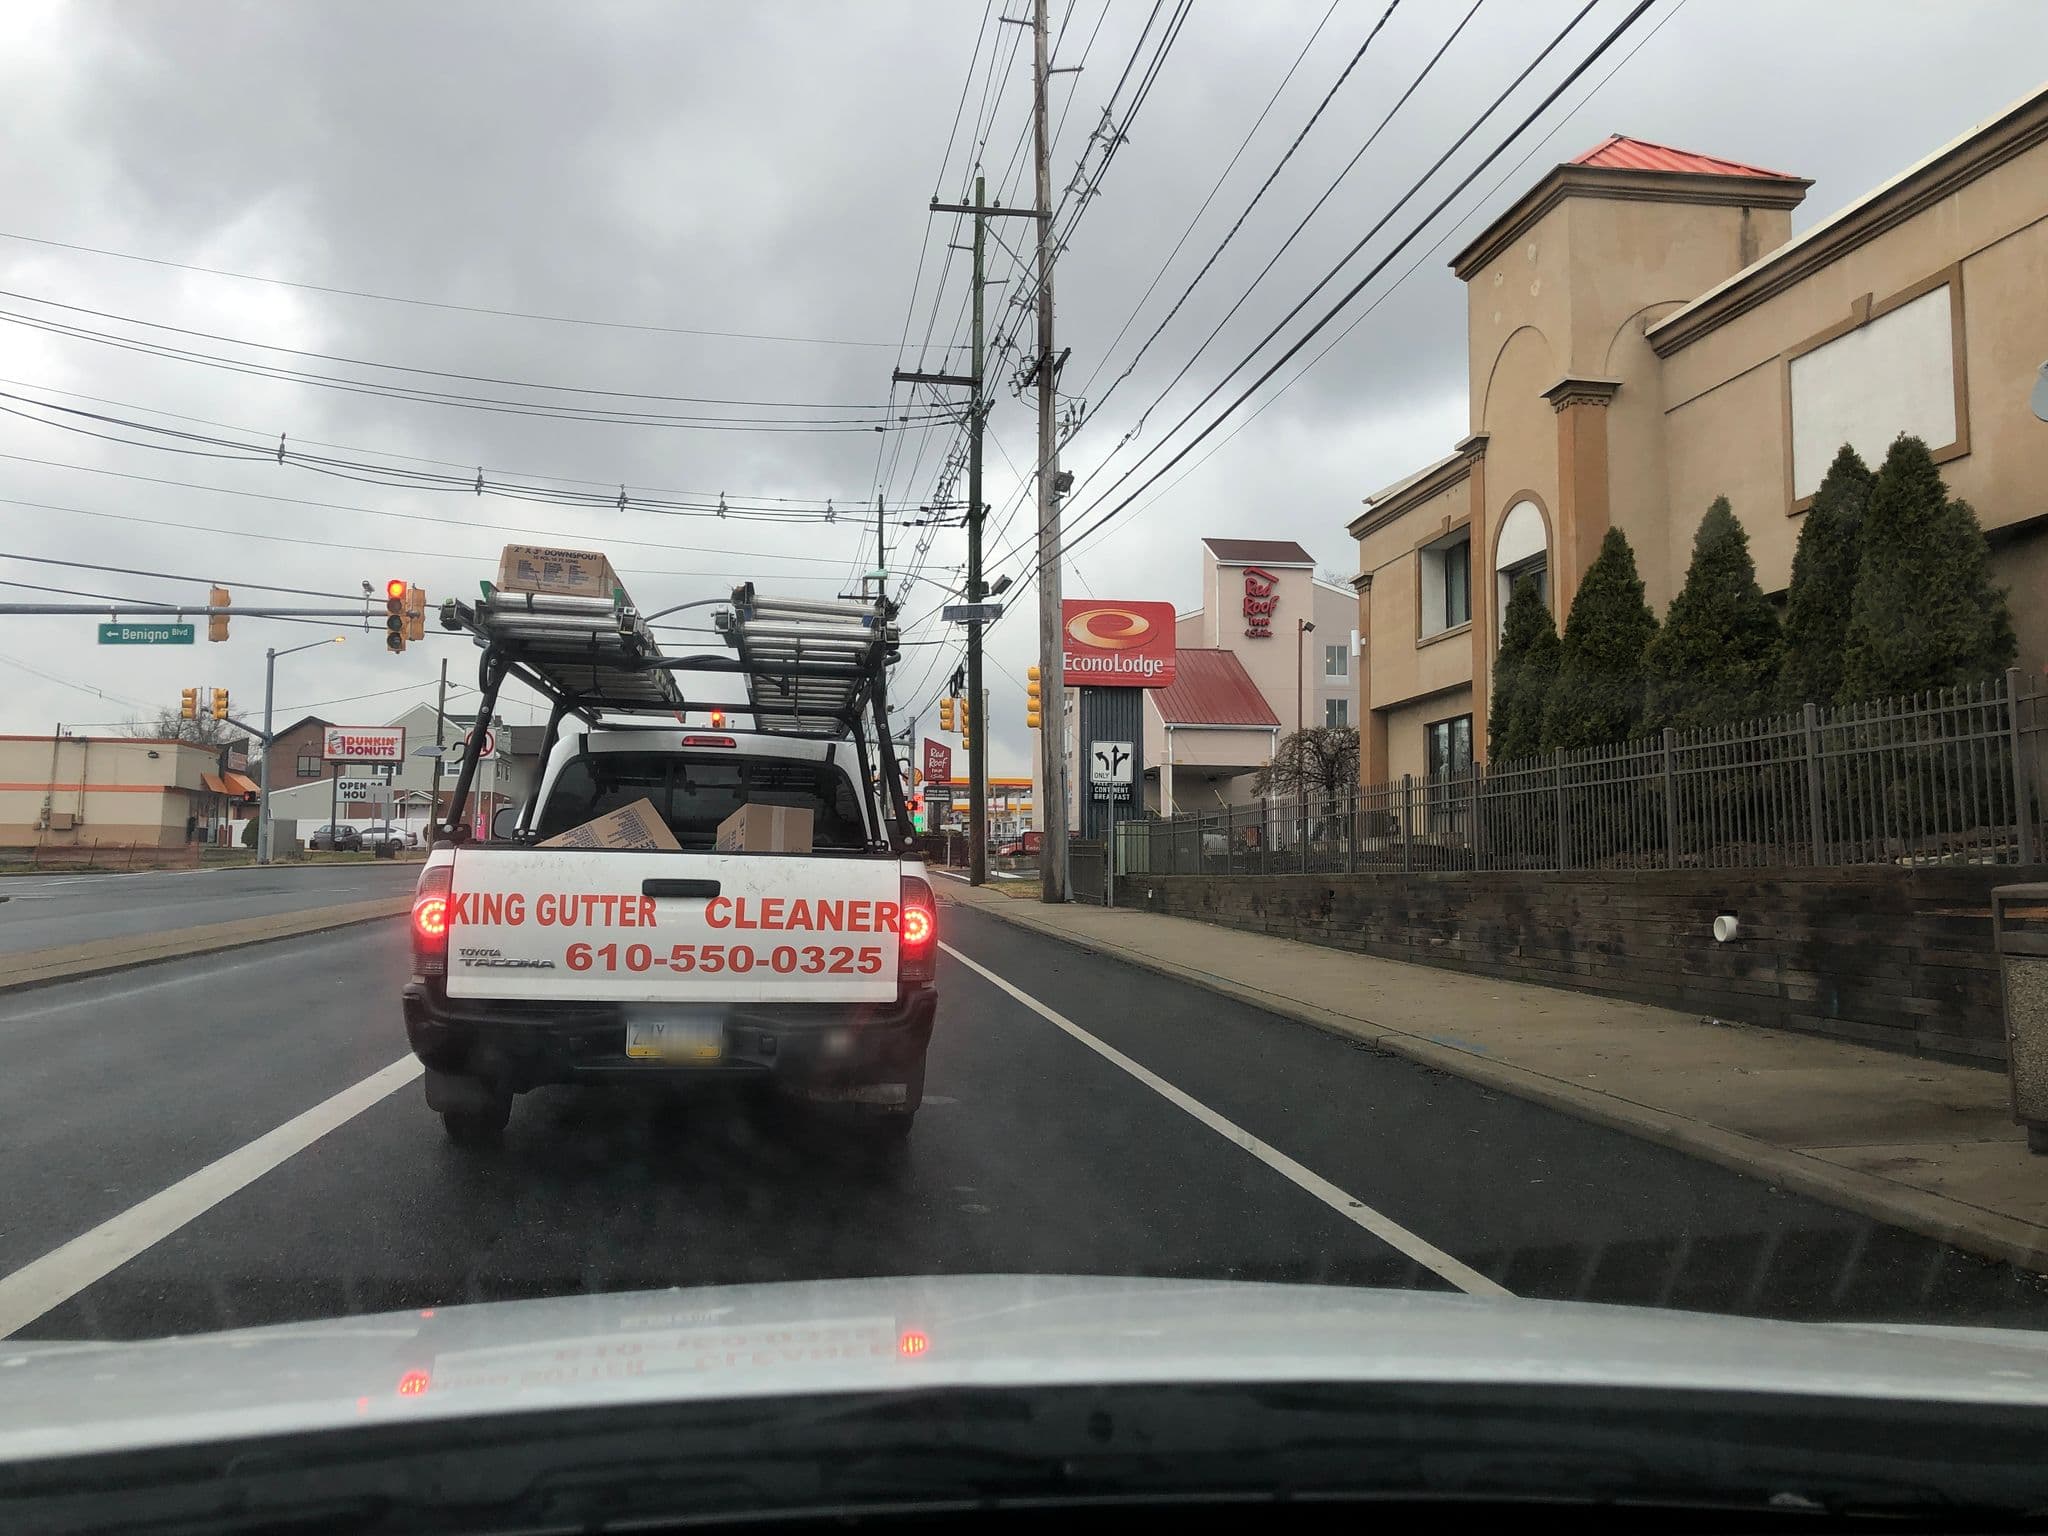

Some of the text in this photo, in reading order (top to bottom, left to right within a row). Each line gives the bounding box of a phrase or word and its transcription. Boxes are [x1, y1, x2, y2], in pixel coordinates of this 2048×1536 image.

[544, 549, 597, 561] DOWNSPOUT
[1245, 577, 1273, 597] Red
[1243, 596, 1280, 617] Roof
[122, 628, 188, 643] Benigno Blvd
[1062, 652, 1163, 677] EconoLodge
[346, 736, 398, 746] DUNKIN'
[346, 746, 395, 756] DONUTS
[930, 747, 945, 758] Red
[929, 757, 948, 769] Roof
[339, 782, 367, 790] OPEN
[343, 791, 366, 799] HOU
[451, 892, 900, 933] KING GUTTER CLEANER
[458, 948, 502, 957] TOYOTA
[565, 942, 882, 974] 610-550-0325
[458, 958, 556, 969] TACOMA
